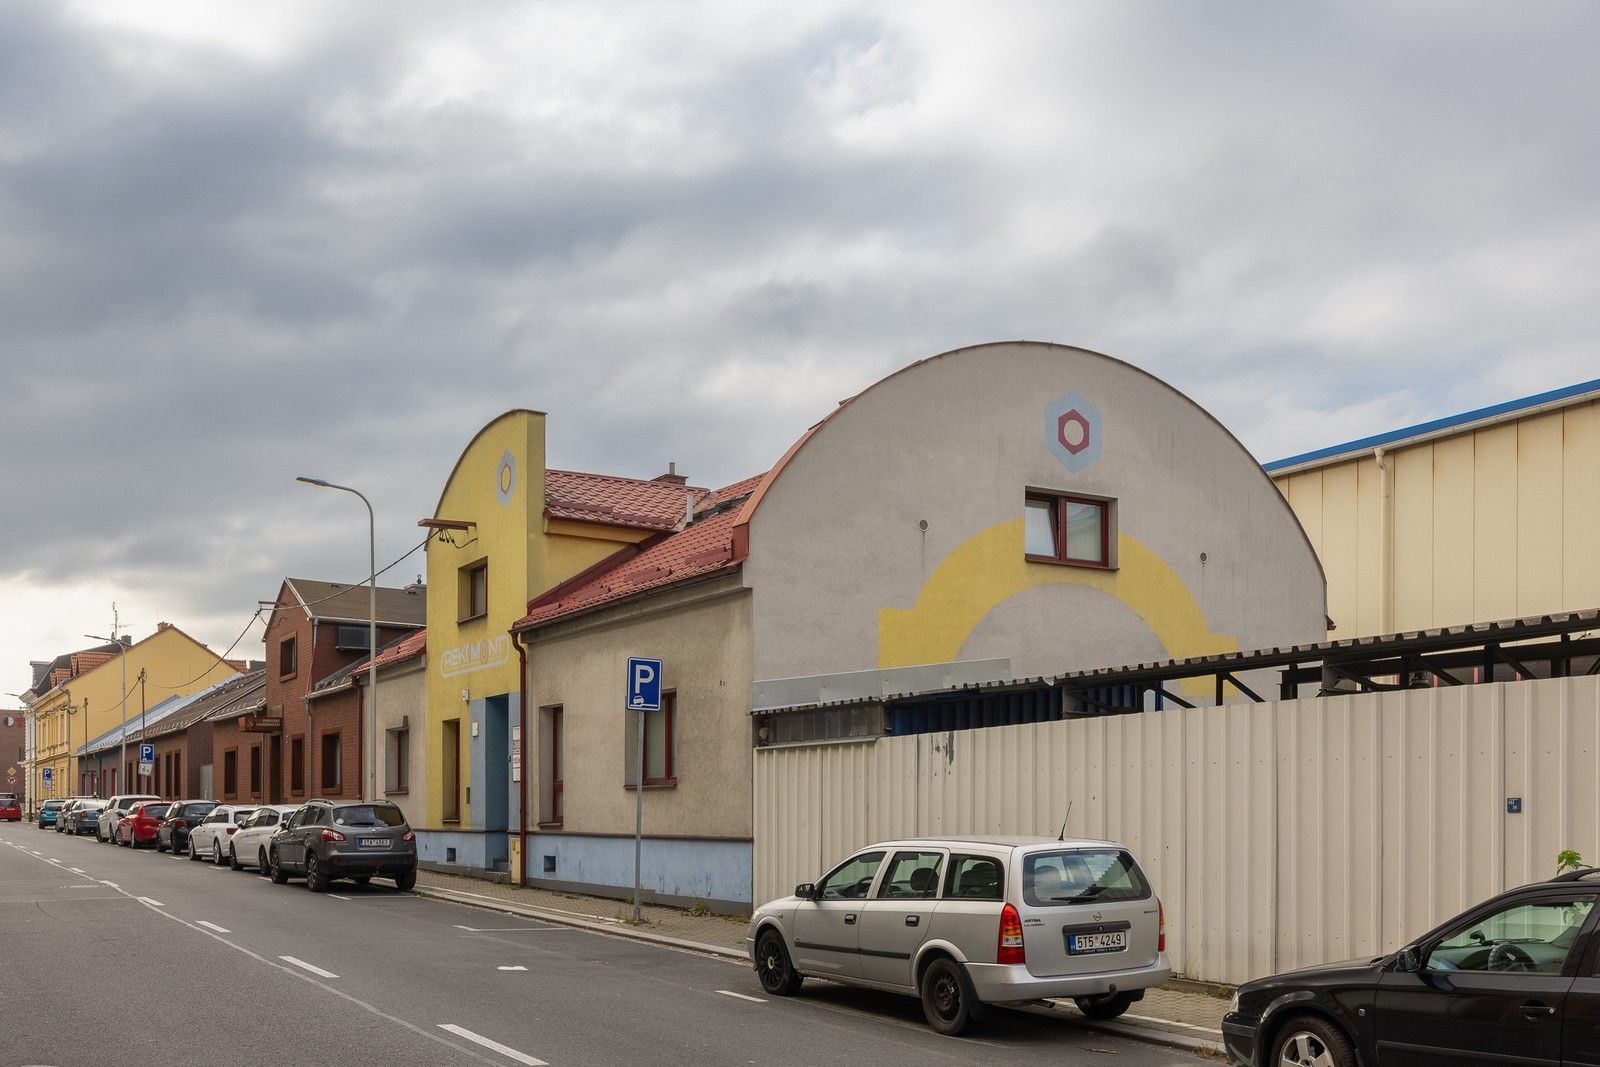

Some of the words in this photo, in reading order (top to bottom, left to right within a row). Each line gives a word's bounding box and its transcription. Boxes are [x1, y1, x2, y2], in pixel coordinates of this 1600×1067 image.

[635, 664, 655, 693] P
[143, 746, 152, 757] P
[1077, 936, 1094, 948] 5T5
[1100, 934, 1122, 947] 4249
